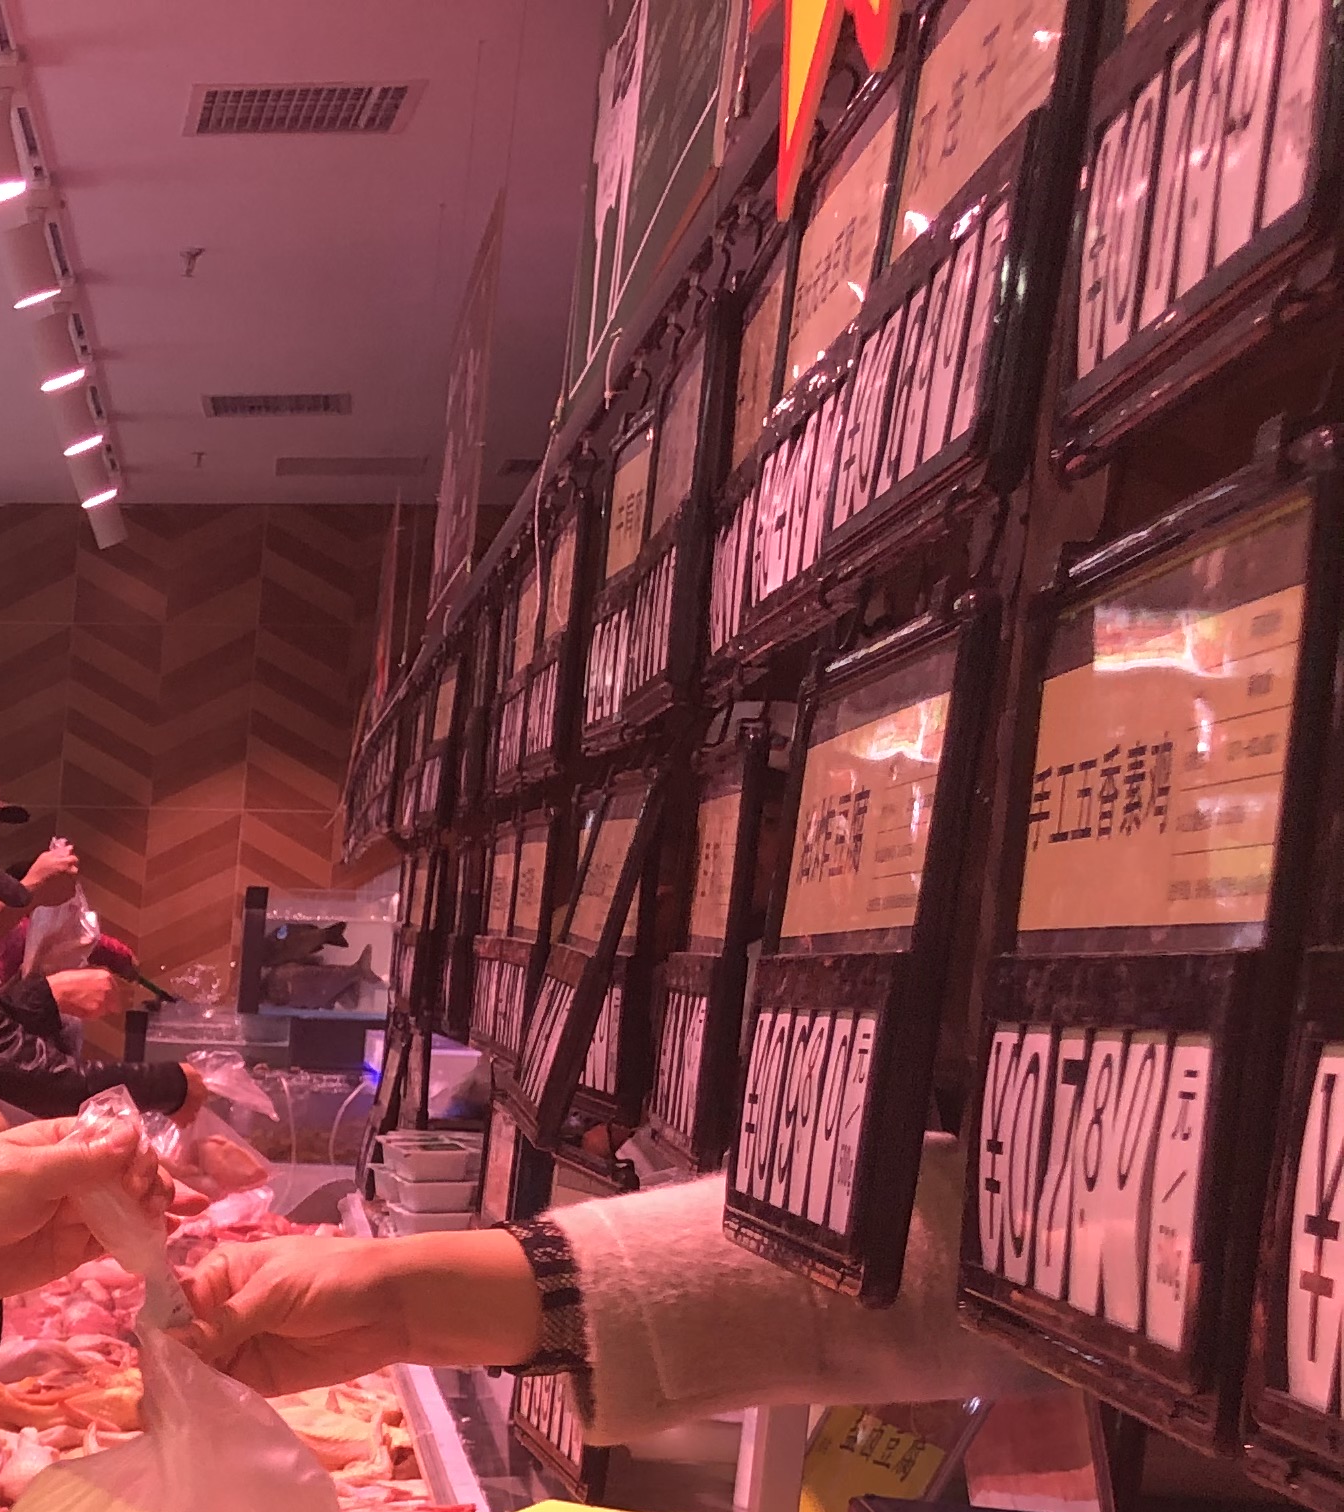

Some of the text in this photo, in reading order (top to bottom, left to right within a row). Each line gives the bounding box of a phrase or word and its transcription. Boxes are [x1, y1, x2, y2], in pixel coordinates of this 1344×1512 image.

[1029, 731, 1173, 852] 手工五香素鸡
